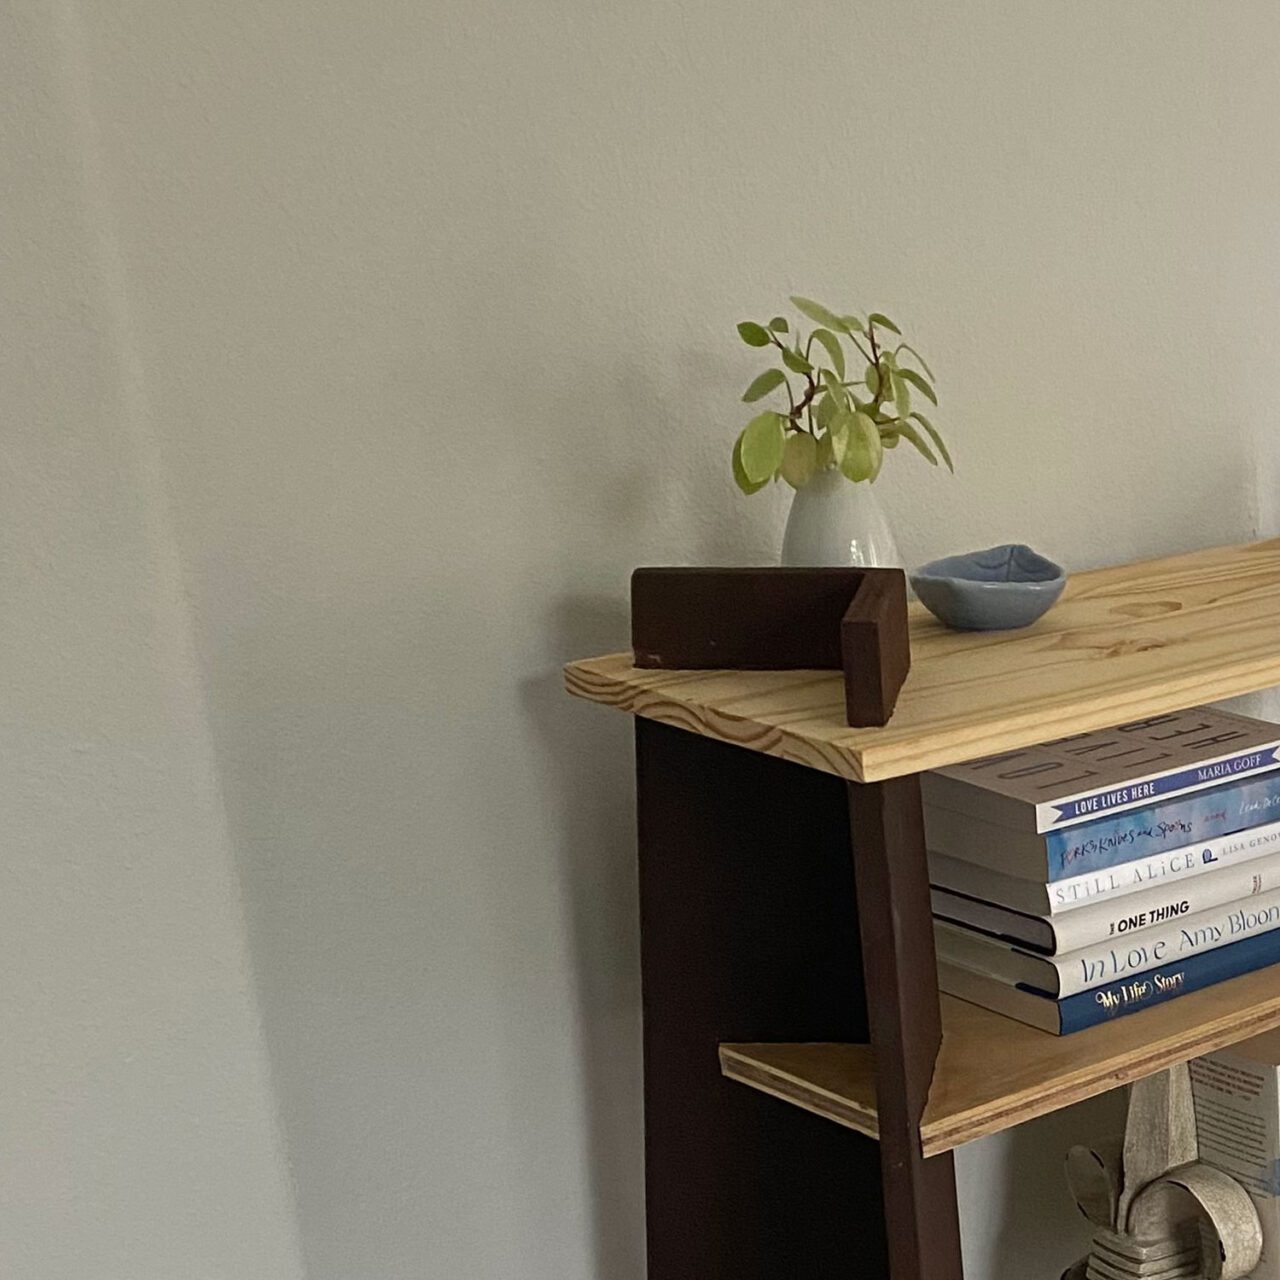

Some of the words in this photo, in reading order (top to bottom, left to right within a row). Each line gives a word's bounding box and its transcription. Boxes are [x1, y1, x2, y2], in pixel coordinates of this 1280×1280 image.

[1198, 762, 1232, 781] MARIA
[1233, 754, 1262, 771] GOFF
[1075, 799, 1099, 815] LOVE
[1101, 789, 1129, 808] LIVES
[1131, 782, 1156, 798] HERE
[1222, 843, 1246, 857] LISA
[1117, 913, 1147, 933] ONE
[1148, 900, 1190, 924] THING
[1179, 924, 1226, 951] Amy
[1081, 959, 1105, 983] In
[1110, 940, 1168, 973] Love
[1095, 989, 1121, 1014] My
[1154, 972, 1185, 993] Story
